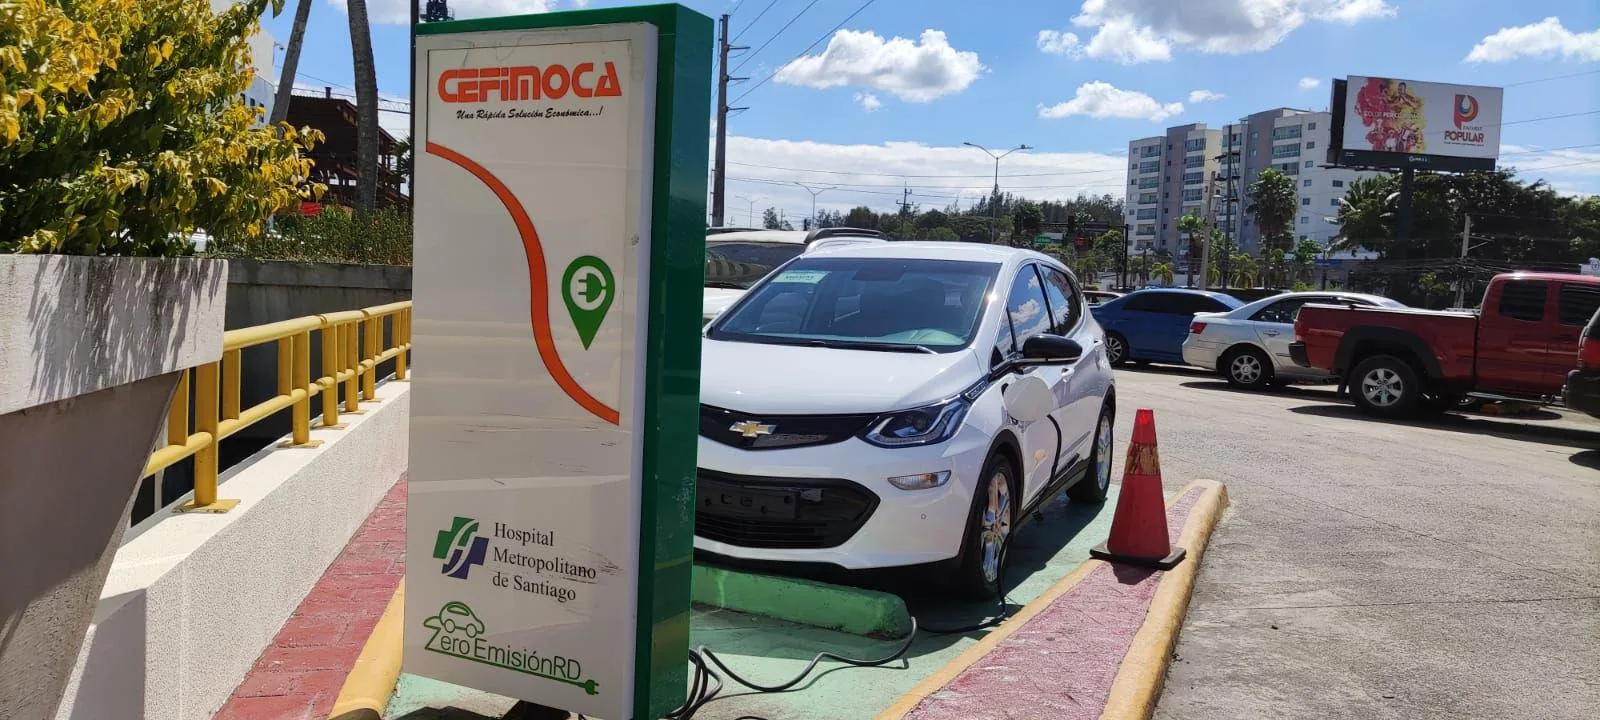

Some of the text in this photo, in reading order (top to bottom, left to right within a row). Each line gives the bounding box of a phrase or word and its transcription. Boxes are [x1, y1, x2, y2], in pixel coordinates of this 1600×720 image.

[456, 109, 474, 120] Una
[476, 109, 506, 121] Rápida
[508, 108, 543, 119] Solución
[1444, 130, 1485, 143] POPULAR
[494, 522, 554, 547] Hospital
[492, 547, 597, 579] Metropolitano
[492, 572, 577, 603] de Santiago
